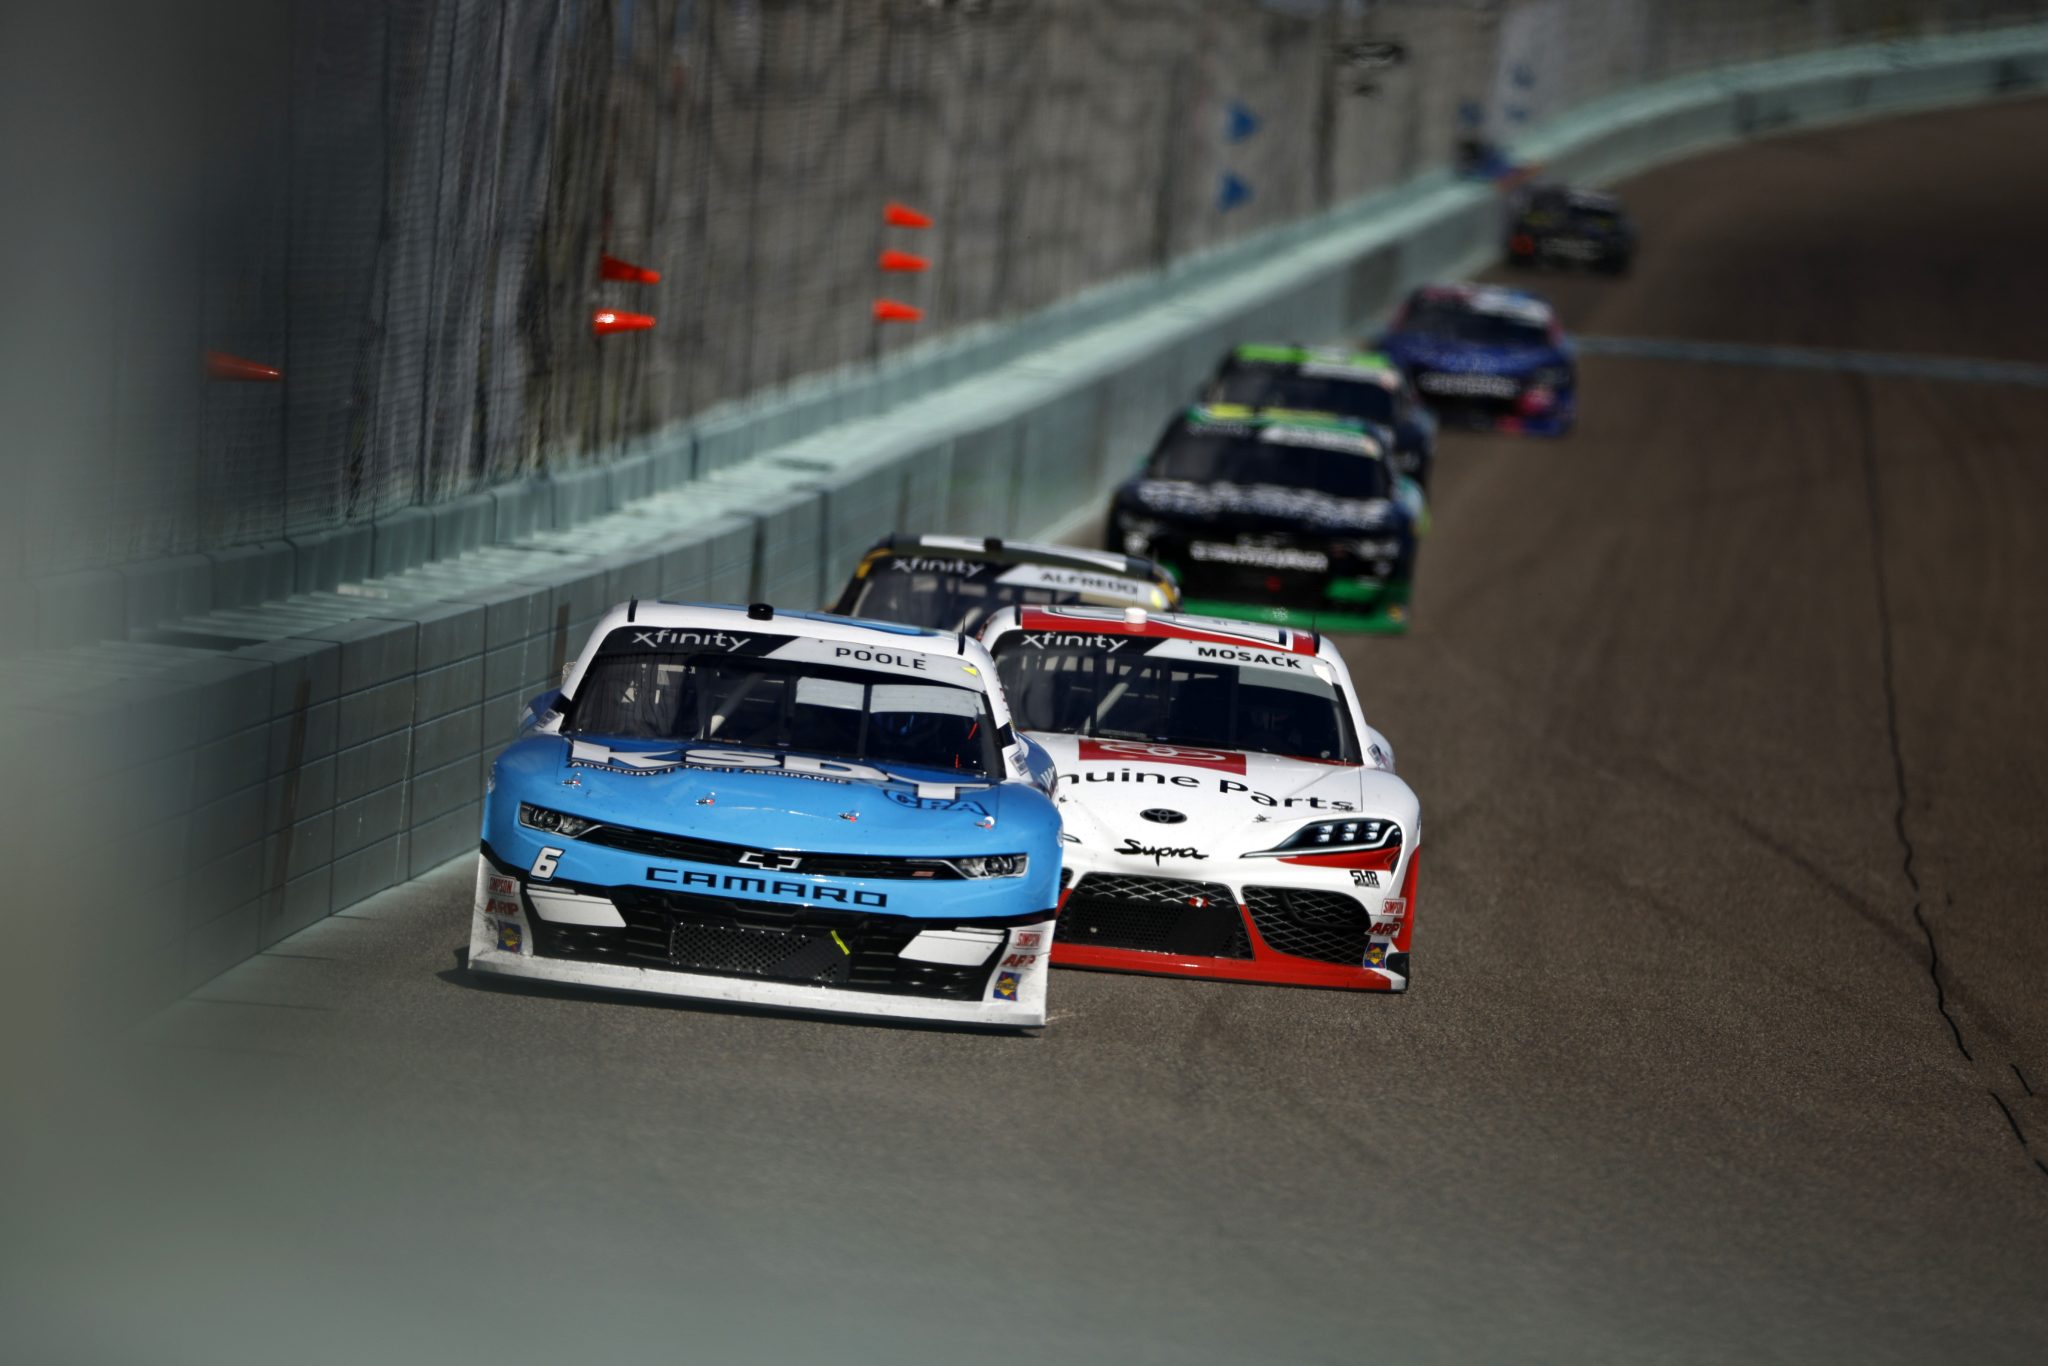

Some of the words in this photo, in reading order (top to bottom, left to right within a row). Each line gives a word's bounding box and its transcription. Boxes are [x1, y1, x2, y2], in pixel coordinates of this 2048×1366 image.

[892, 557, 985, 578] xfinity
[1041, 573, 1138, 594] ALFREDO
[632, 629, 751, 652] xfinity
[1021, 632, 1128, 653] xfinity
[835, 647, 927, 670] POOLE
[1198, 647, 1302, 669] MOSACK
[570, 761, 657, 776] ADVISORY
[685, 764, 713, 772] TAX
[744, 768, 849, 784] ASSURANCE
[1219, 779, 1355, 811] Parts
[530, 846, 565, 880] 6
[1114, 838, 1209, 867] Supra
[645, 866, 888, 908] CAMARO
[485, 898, 519, 916] ARP
[1368, 922, 1400, 935] ARP
